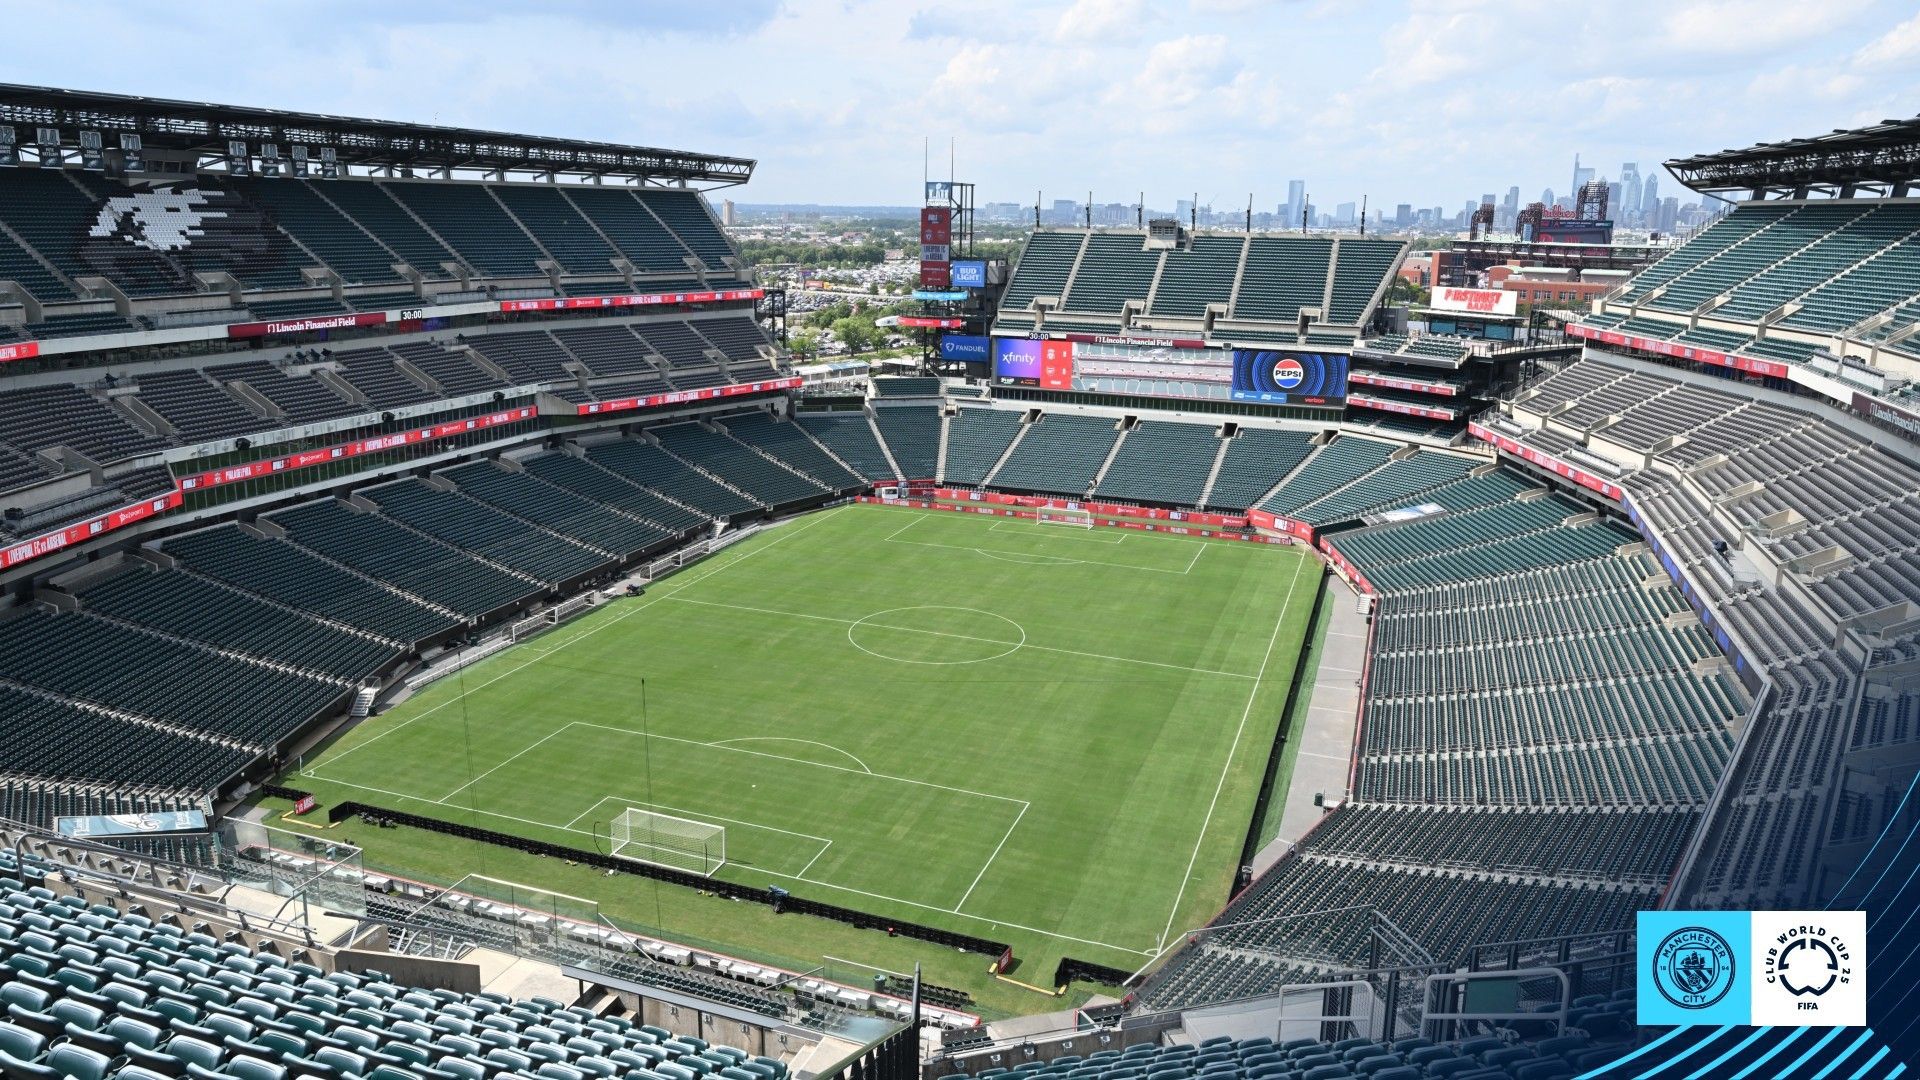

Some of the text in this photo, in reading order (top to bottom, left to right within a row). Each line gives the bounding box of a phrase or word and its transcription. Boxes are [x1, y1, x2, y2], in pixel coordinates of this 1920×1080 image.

[1467, 301, 1494, 312] BANK
[402, 310, 422, 320] 30:00
[276, 317, 355, 333] Lincoln Financial Field
[1029, 332, 1049, 340] 30:00
[1102, 336, 1173, 347] Lincoln Financial Field
[955, 344, 985, 352] FANDUEL
[1002, 352, 1036, 365] xfinity
[1275, 370, 1302, 378] PEPSI
[1874, 404, 1892, 422] Lincoln
[1892, 410, 1915, 432] Financial
[8, 544, 33, 565] LIVERPOOL
[33, 541, 41, 555] FC
[46, 532, 67, 550] ARSENAL
